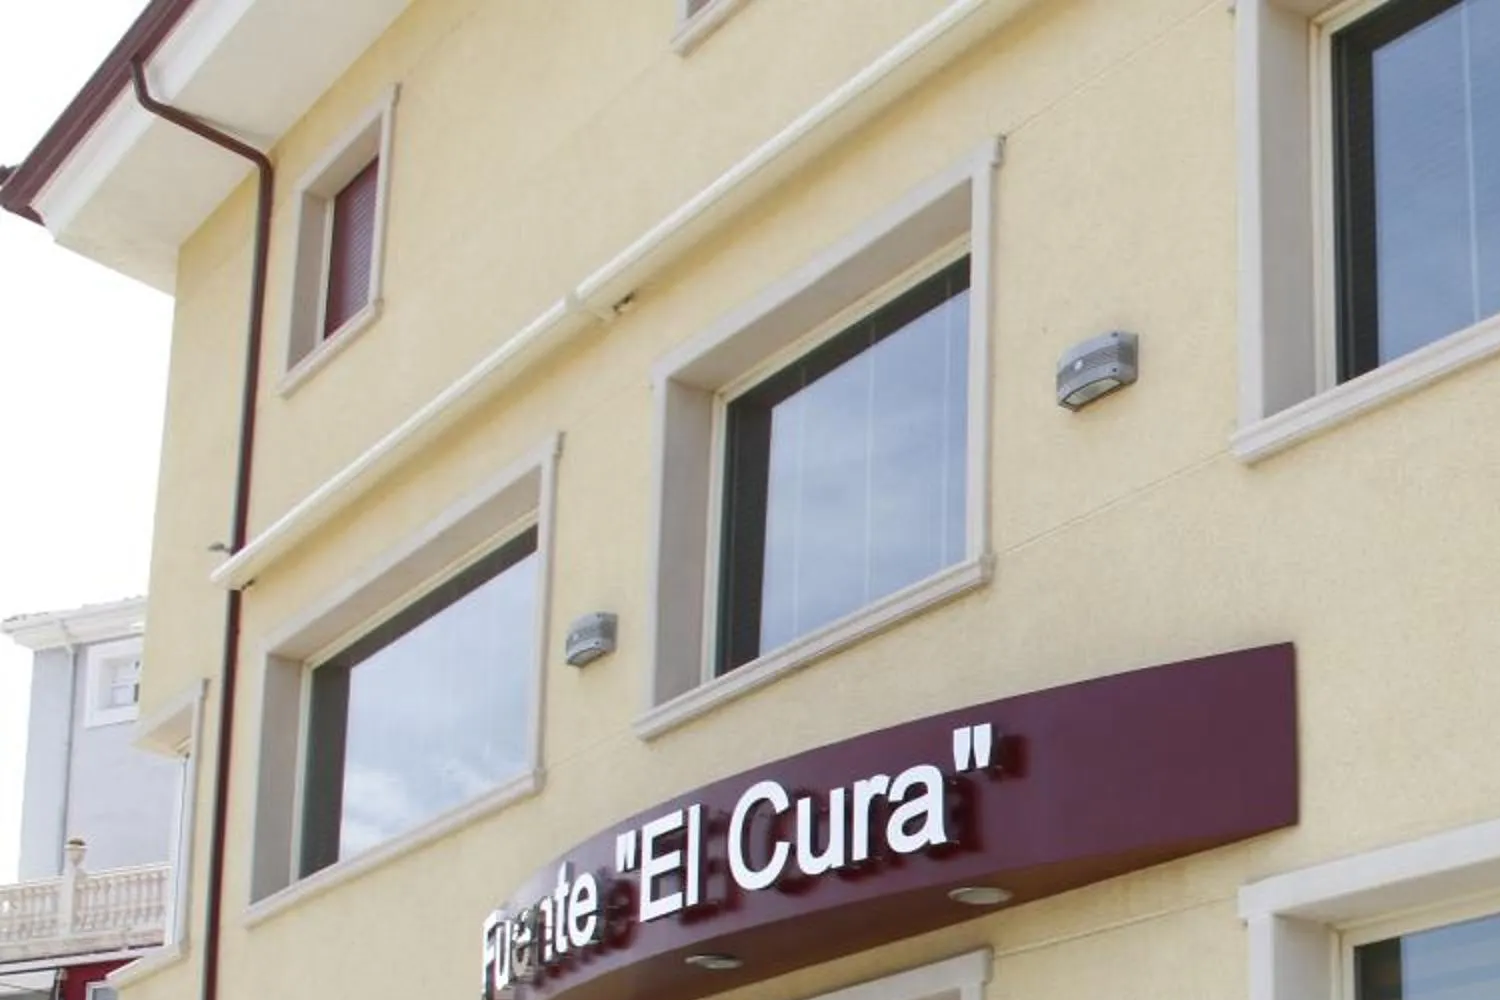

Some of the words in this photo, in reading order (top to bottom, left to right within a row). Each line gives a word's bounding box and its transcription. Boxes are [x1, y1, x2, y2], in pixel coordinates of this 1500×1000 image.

[482, 860, 598, 996] Fuente
[616, 804, 700, 922] "El
[727, 723, 992, 891] Cura"
